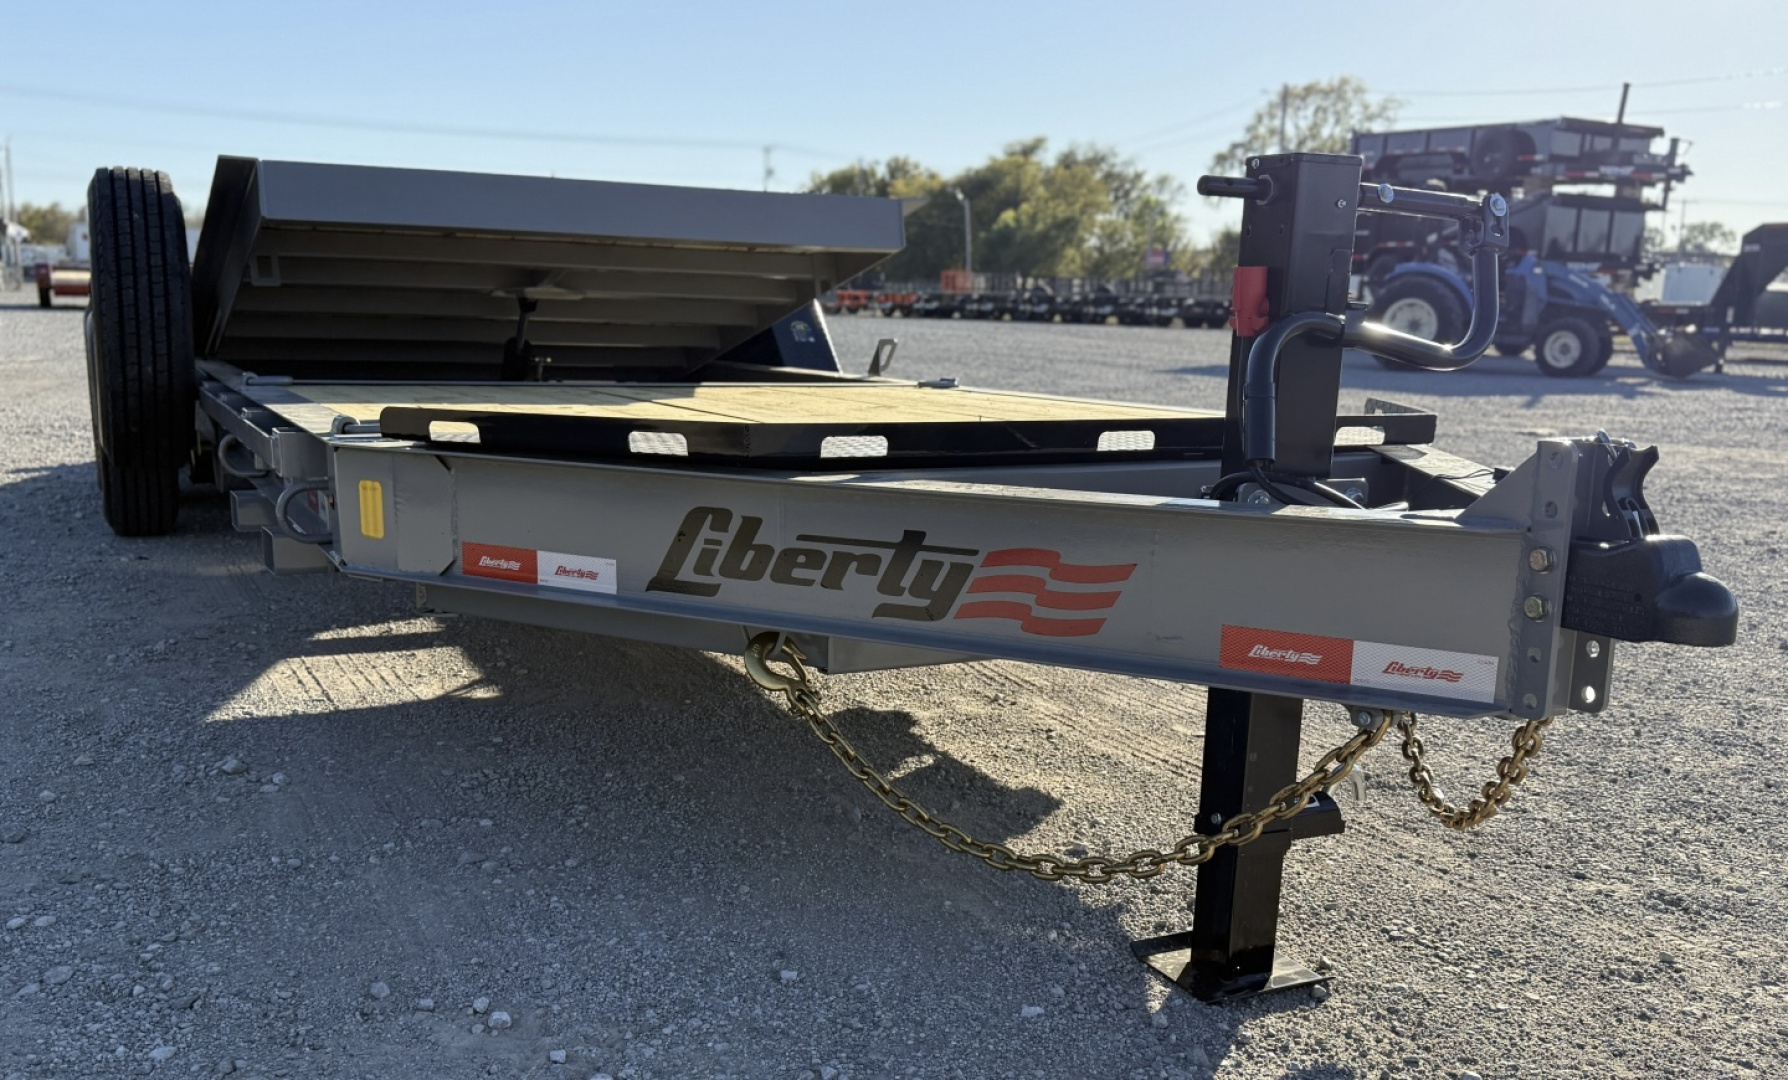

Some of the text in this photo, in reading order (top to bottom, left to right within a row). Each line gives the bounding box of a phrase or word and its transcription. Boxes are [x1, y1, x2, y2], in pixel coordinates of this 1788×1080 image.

[479, 555, 509, 570] Liberty
[645, 506, 980, 622] Liberty
[555, 565, 586, 579] Liberty
[1248, 644, 1301, 662] Liberty
[1382, 661, 1439, 679] Liberty
